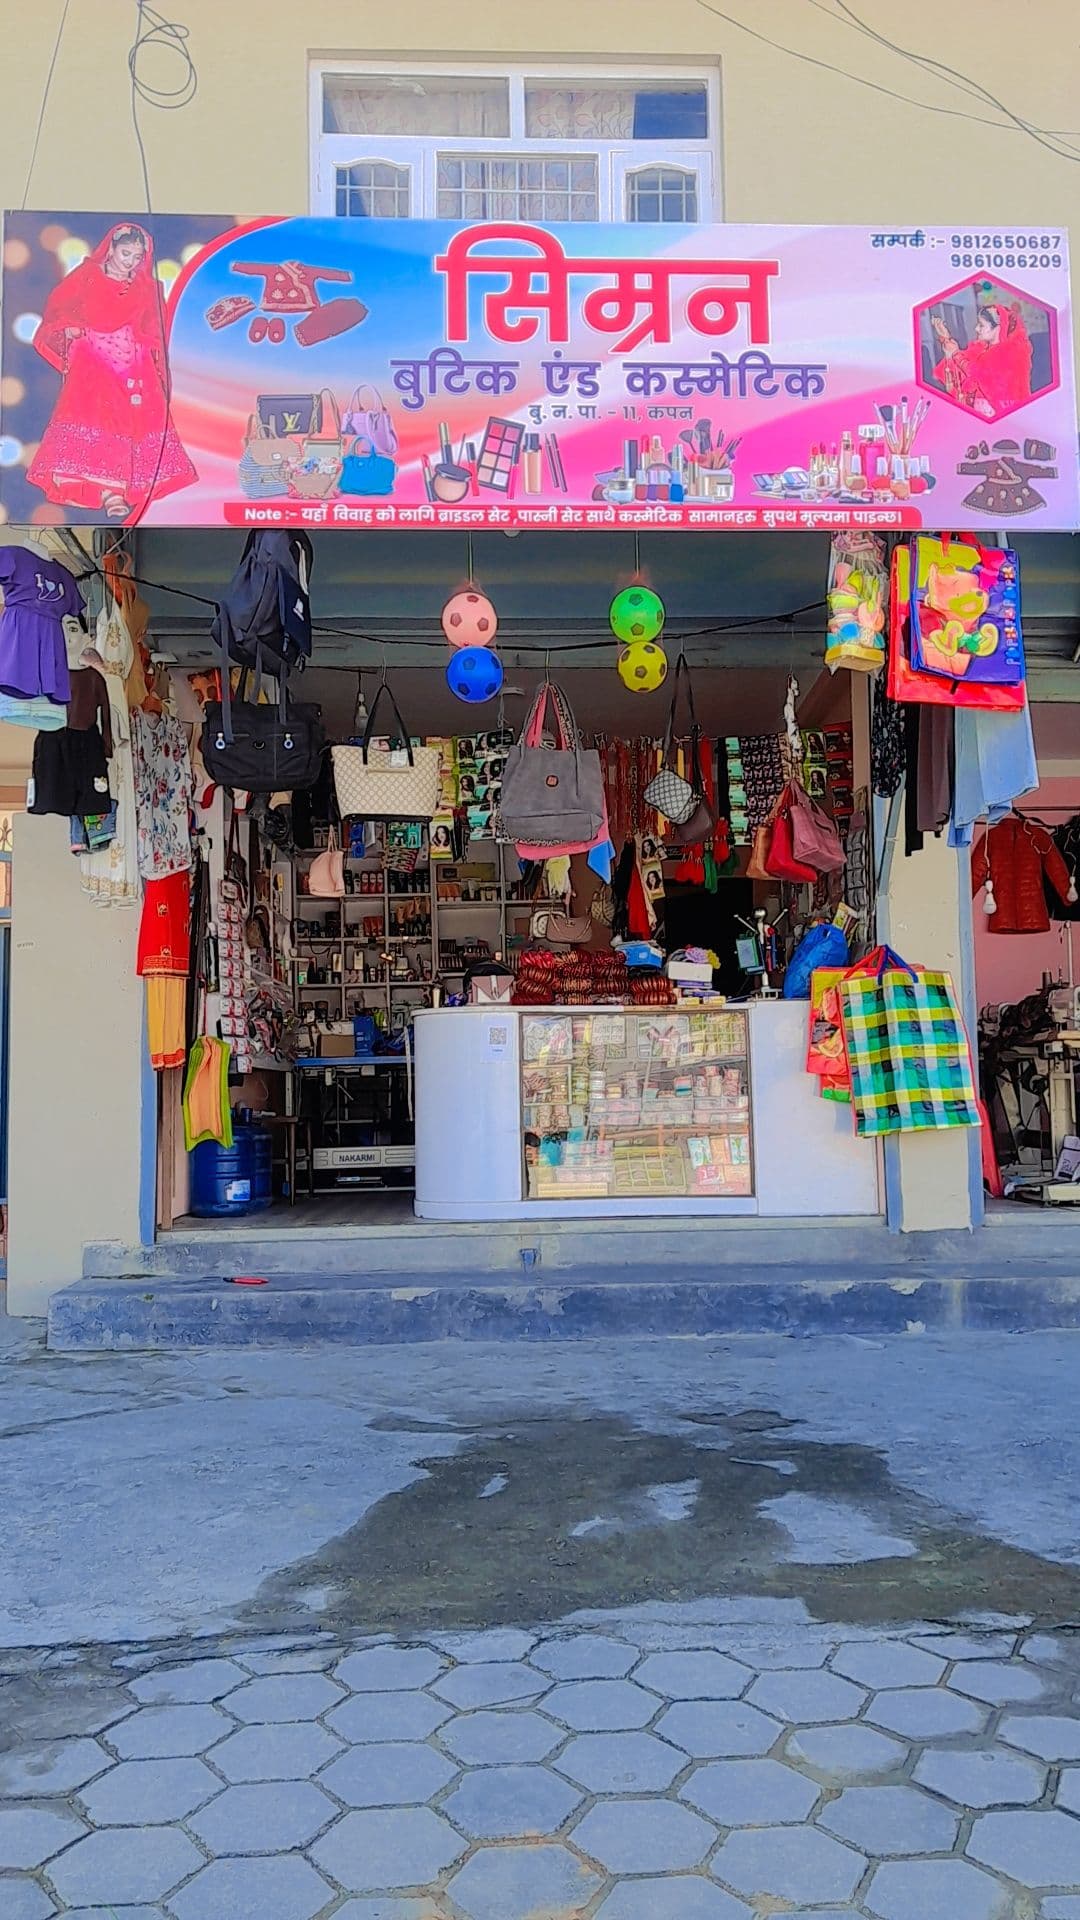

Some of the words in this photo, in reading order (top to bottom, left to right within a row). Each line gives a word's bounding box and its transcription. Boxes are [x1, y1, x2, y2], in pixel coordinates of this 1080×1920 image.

[871, 230, 926, 248] सम्पर्क
[951, 235, 1061, 249] 9812650687
[951, 254, 1062, 268] 9861086209
[435, 222, 780, 354] सिम्रन
[390, 347, 520, 410] बुटिक
[541, 350, 602, 397] एंड
[622, 350, 828, 398] कस्मेटिक
[551, 405, 573, 420] न.
[577, 405, 602, 420] पा.
[648, 406, 694, 420] कपन
[244, 508, 282, 521] Note
[301, 503, 329, 522] यहाँ
[333, 504, 373, 523] विवाह
[375, 505, 396, 522] को
[399, 505, 435, 522] लागि
[437, 508, 486, 523] ब्राइडल
[487, 506, 511, 522] सेट
[560, 506, 584, 523] सेट
[586, 506, 617, 523] साथै
[618, 506, 684, 523] कस्मेटिक
[687, 509, 757, 524] सामानहरु
[762, 510, 798, 527] सुपथ
[799, 510, 851, 527] मूल्यमा
[338, 1154, 376, 1163] NAKARMI
